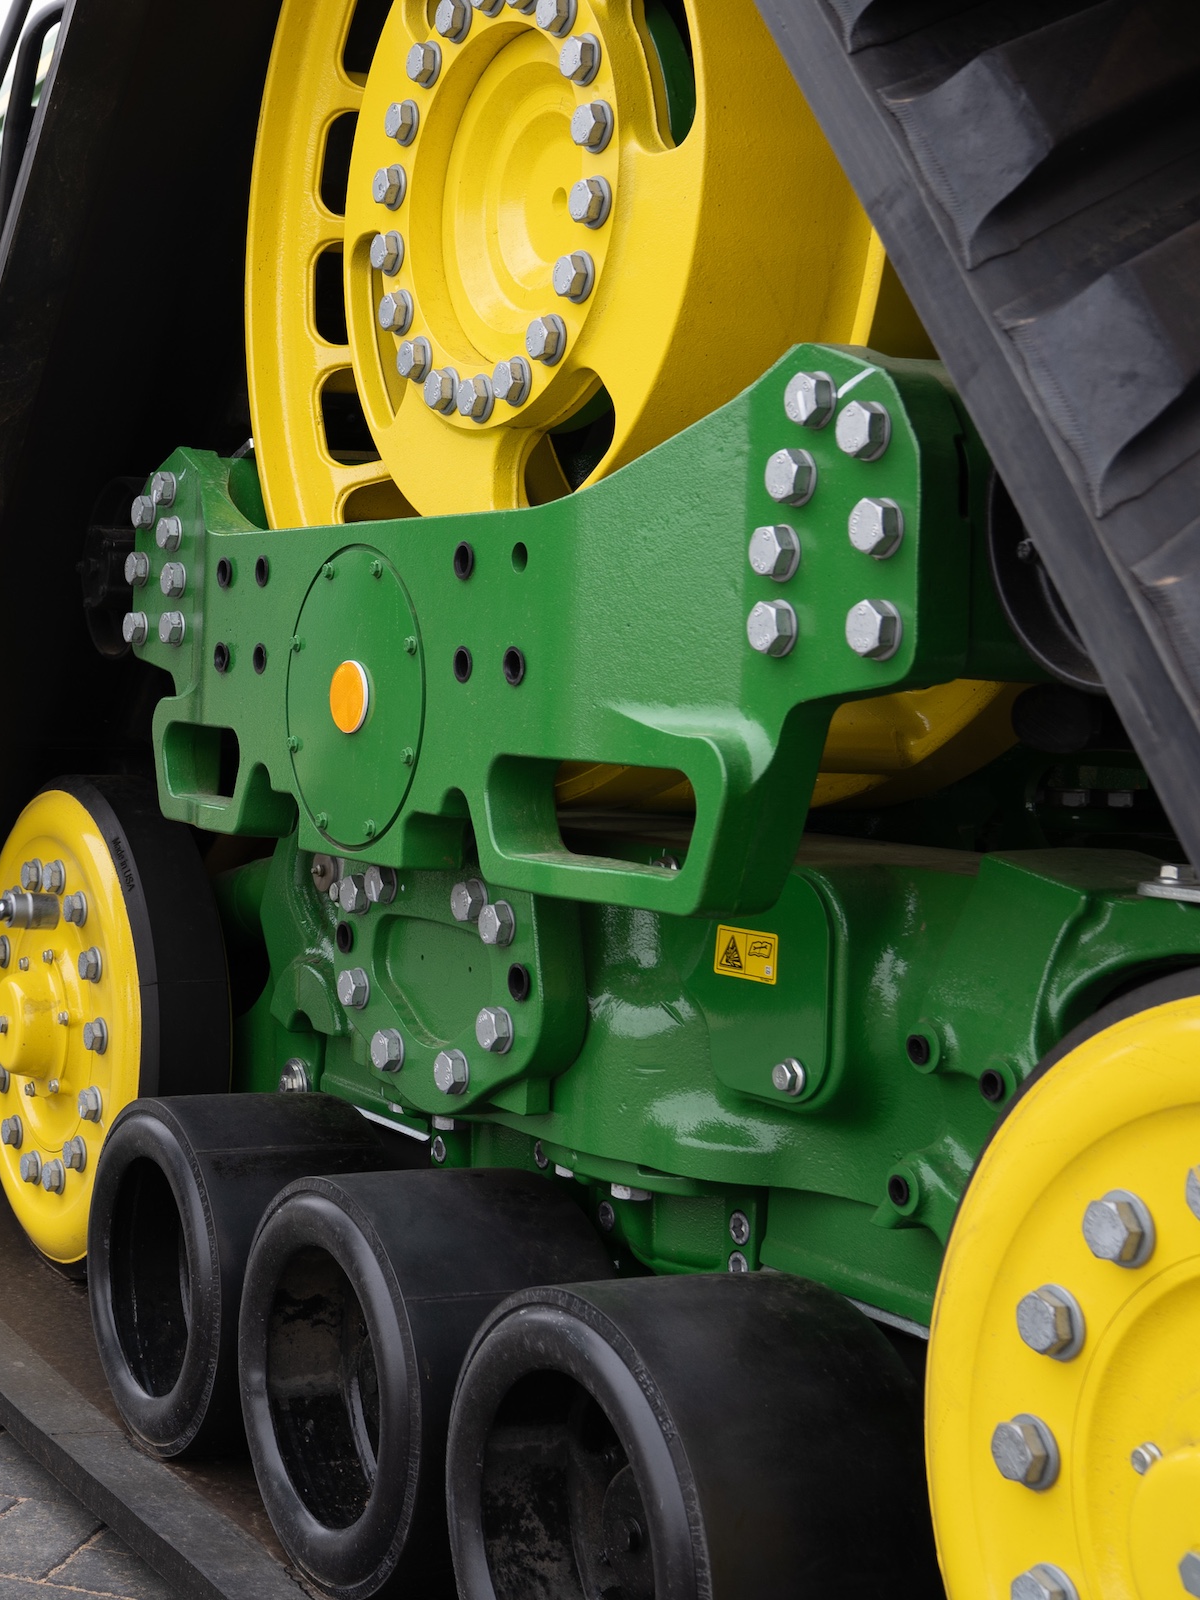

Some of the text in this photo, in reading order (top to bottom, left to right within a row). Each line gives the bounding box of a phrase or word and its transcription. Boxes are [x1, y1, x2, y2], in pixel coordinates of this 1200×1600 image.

[112, 837, 135, 892] Made in USA
